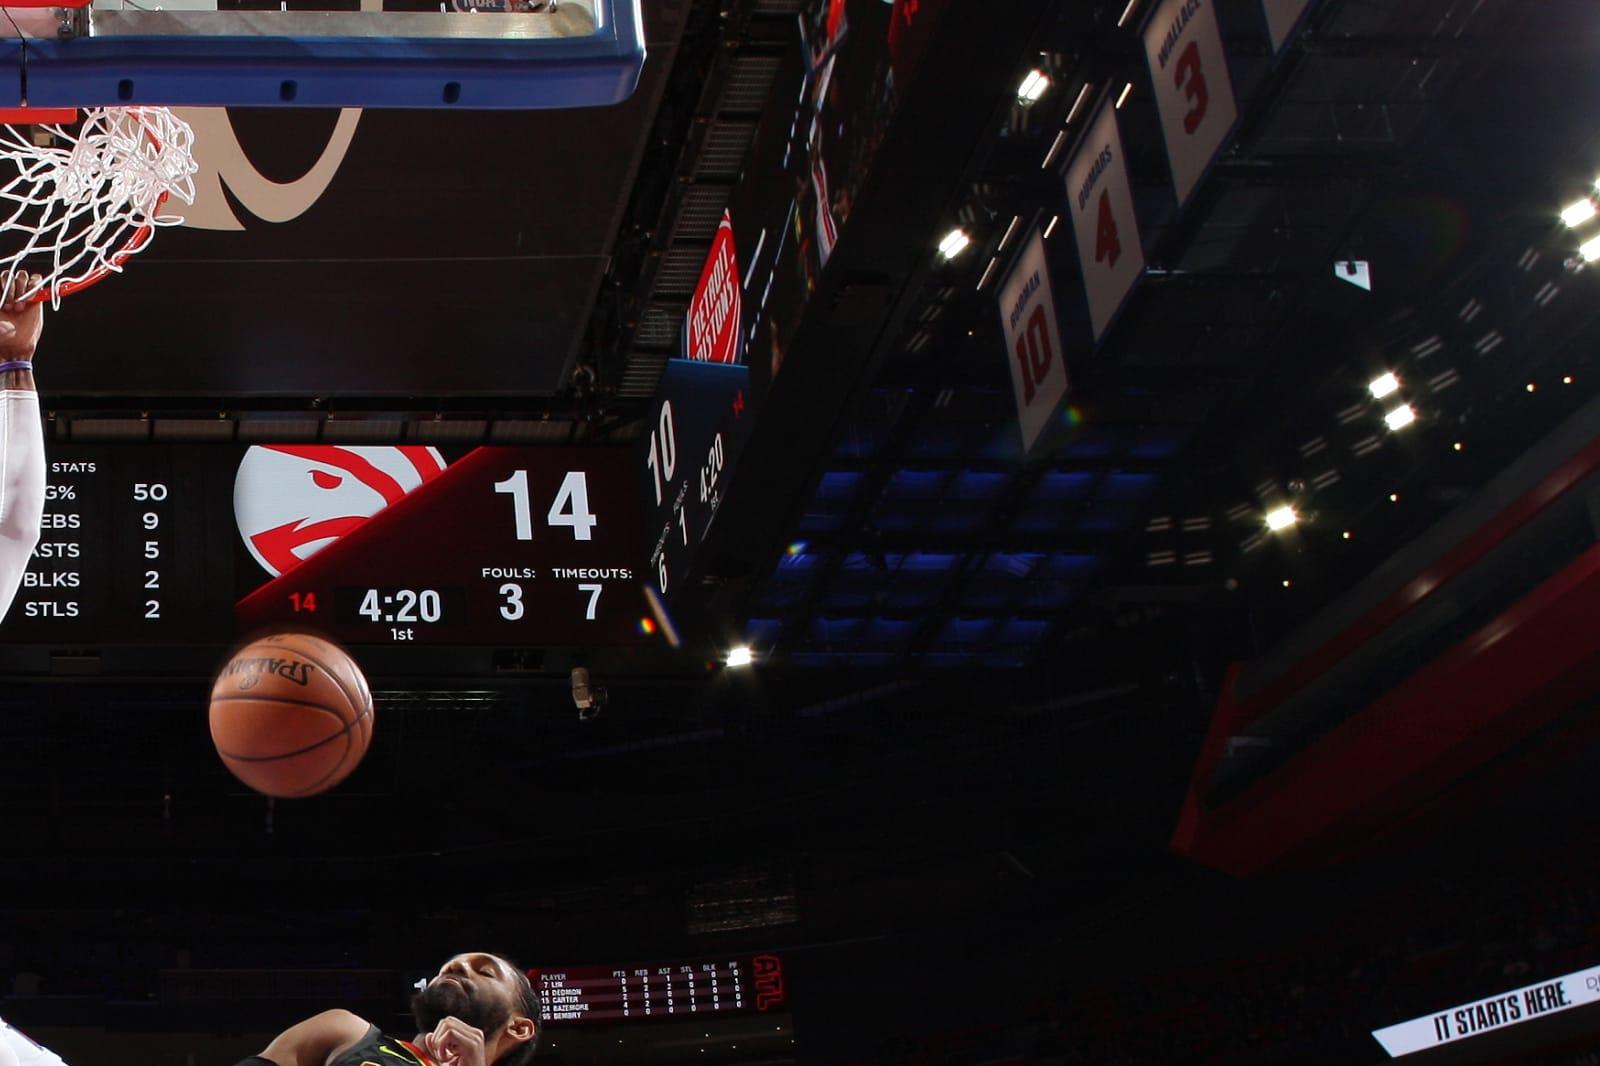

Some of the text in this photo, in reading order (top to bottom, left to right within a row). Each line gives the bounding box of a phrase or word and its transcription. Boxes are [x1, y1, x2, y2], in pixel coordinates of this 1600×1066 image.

[1174, 40, 1209, 135] 3
[1078, 144, 1112, 210] DUMARS
[1095, 187, 1122, 269] 4
[693, 238, 728, 346] DETROIT
[1016, 303, 1052, 407] 10
[52, 462, 96, 473] STATS
[648, 400, 675, 506] 10
[701, 433, 724, 503] 4:20
[45, 485, 76, 500] G%
[134, 484, 167, 501] 50
[494, 469, 597, 541] 14
[40, 514, 80, 529] EBS
[143, 512, 159, 530] 9
[144, 542, 159, 559] 5
[24, 571, 159, 588] BLKS 2
[482, 568, 633, 579] FOULS: TIMEOUTS:
[658, 552, 667, 594] 6
[25, 600, 159, 618] STLS 2
[289, 589, 441, 622] 14 4:20
[499, 583, 602, 620] 3 7
[391, 628, 414, 641] 1st
[753, 955, 783, 1011] ATL
[1434, 1014, 1450, 1041] IT
[1454, 994, 1521, 1035] STARTS
[1523, 982, 1572, 1016] HERE.
